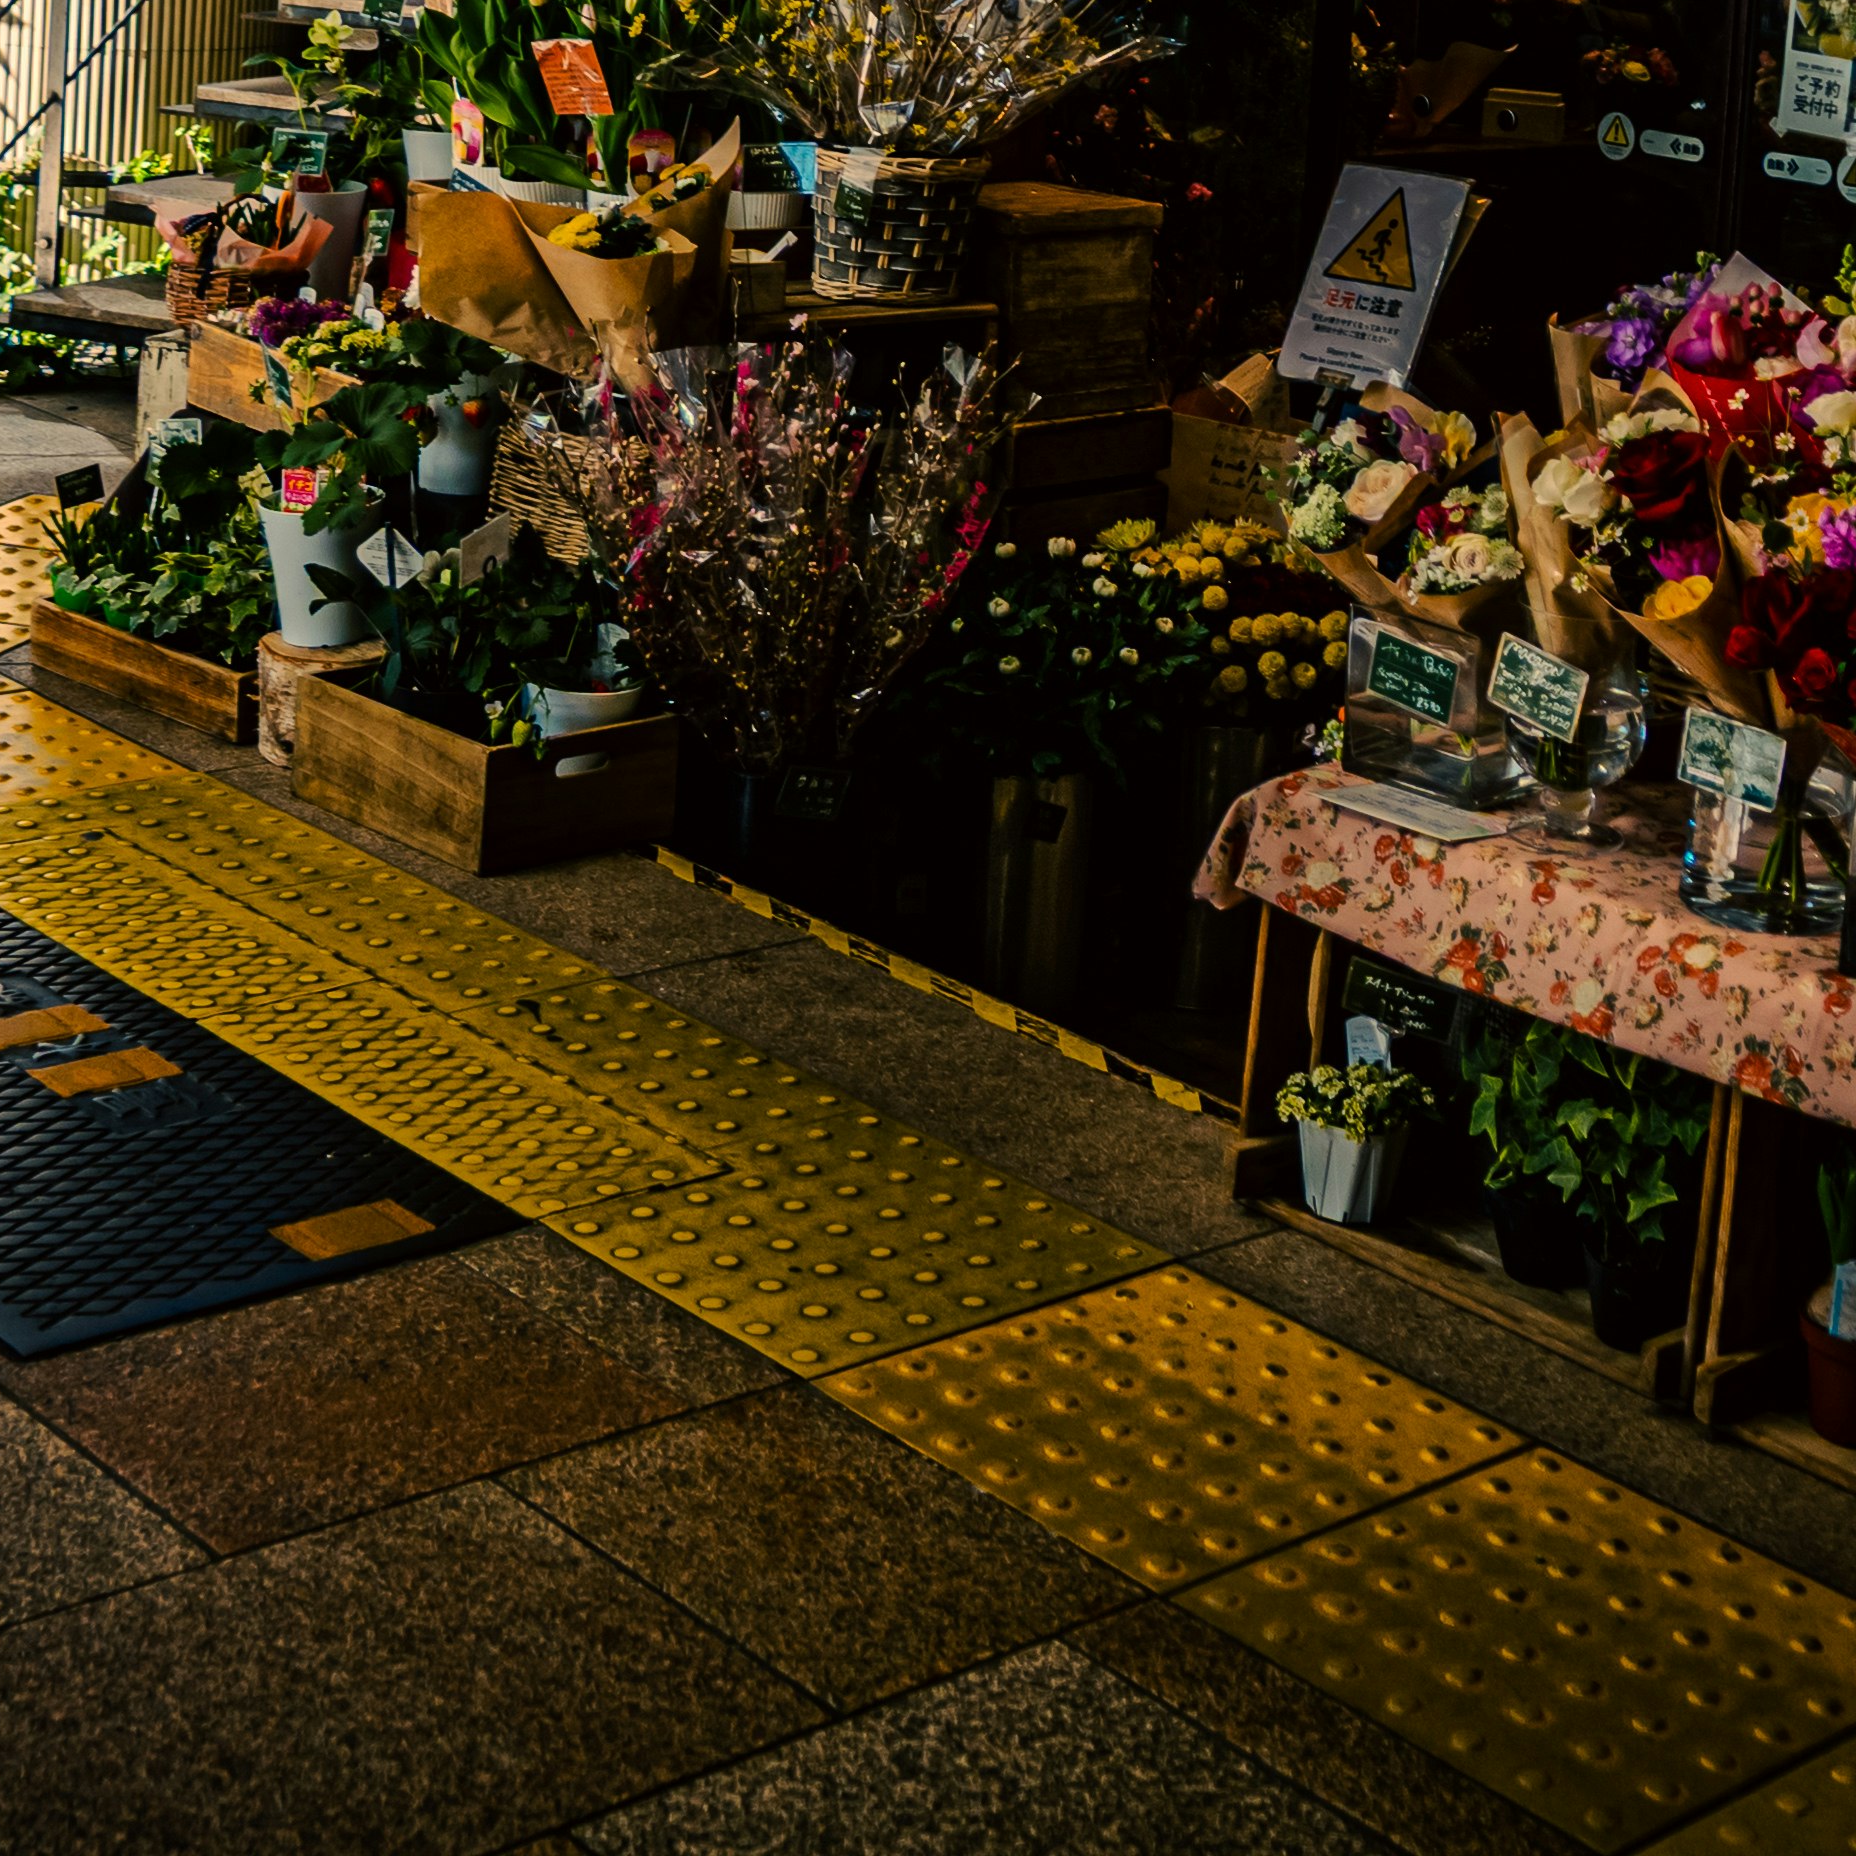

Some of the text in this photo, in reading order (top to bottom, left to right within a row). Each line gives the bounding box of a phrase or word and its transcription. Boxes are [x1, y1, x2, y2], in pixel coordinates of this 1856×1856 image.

[1795, 74, 1842, 98] ご予約
[1793, 94, 1838, 119] 受付中
[1323, 288, 1403, 318] 足元に注意
